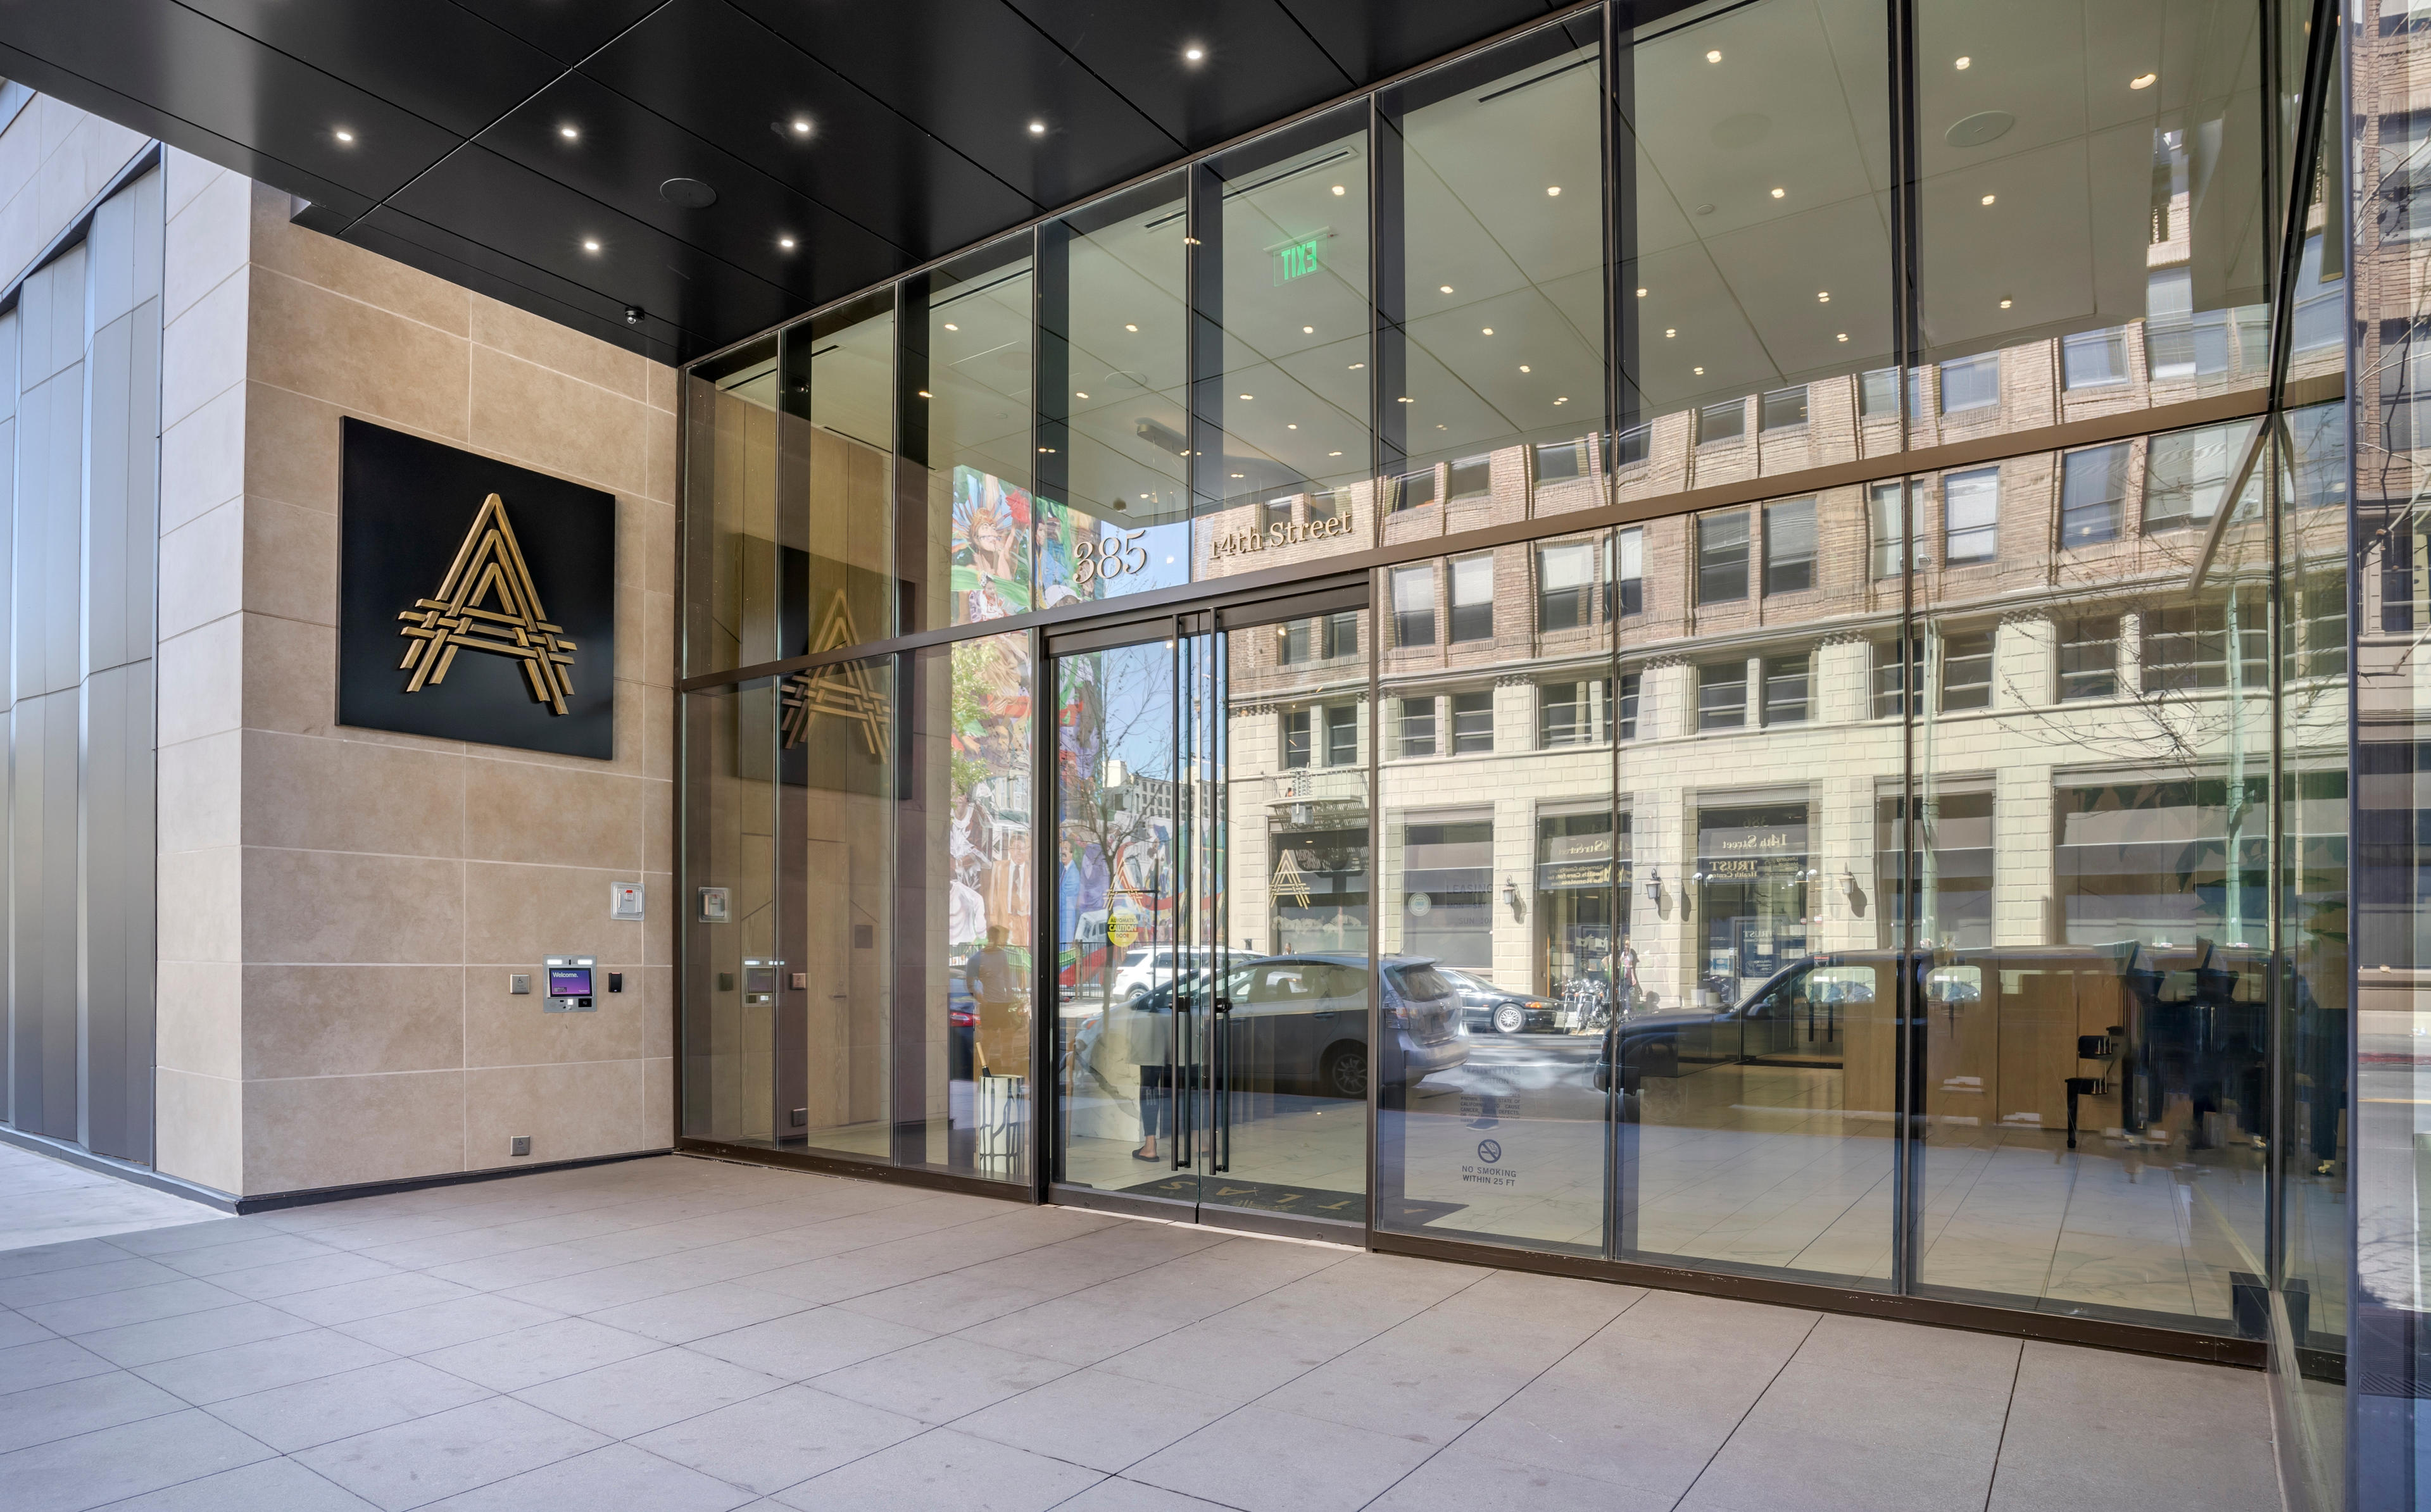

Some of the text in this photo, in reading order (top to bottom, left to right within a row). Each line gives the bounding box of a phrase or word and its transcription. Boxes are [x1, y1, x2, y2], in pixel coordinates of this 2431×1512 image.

[1209, 511, 1353, 559] 14th Street
[1072, 530, 1147, 584] 385
[1447, 884, 1493, 894] LEASING
[1477, 1166, 1516, 1178] SMOKING
[1462, 1174, 1491, 1184] WITHIN
